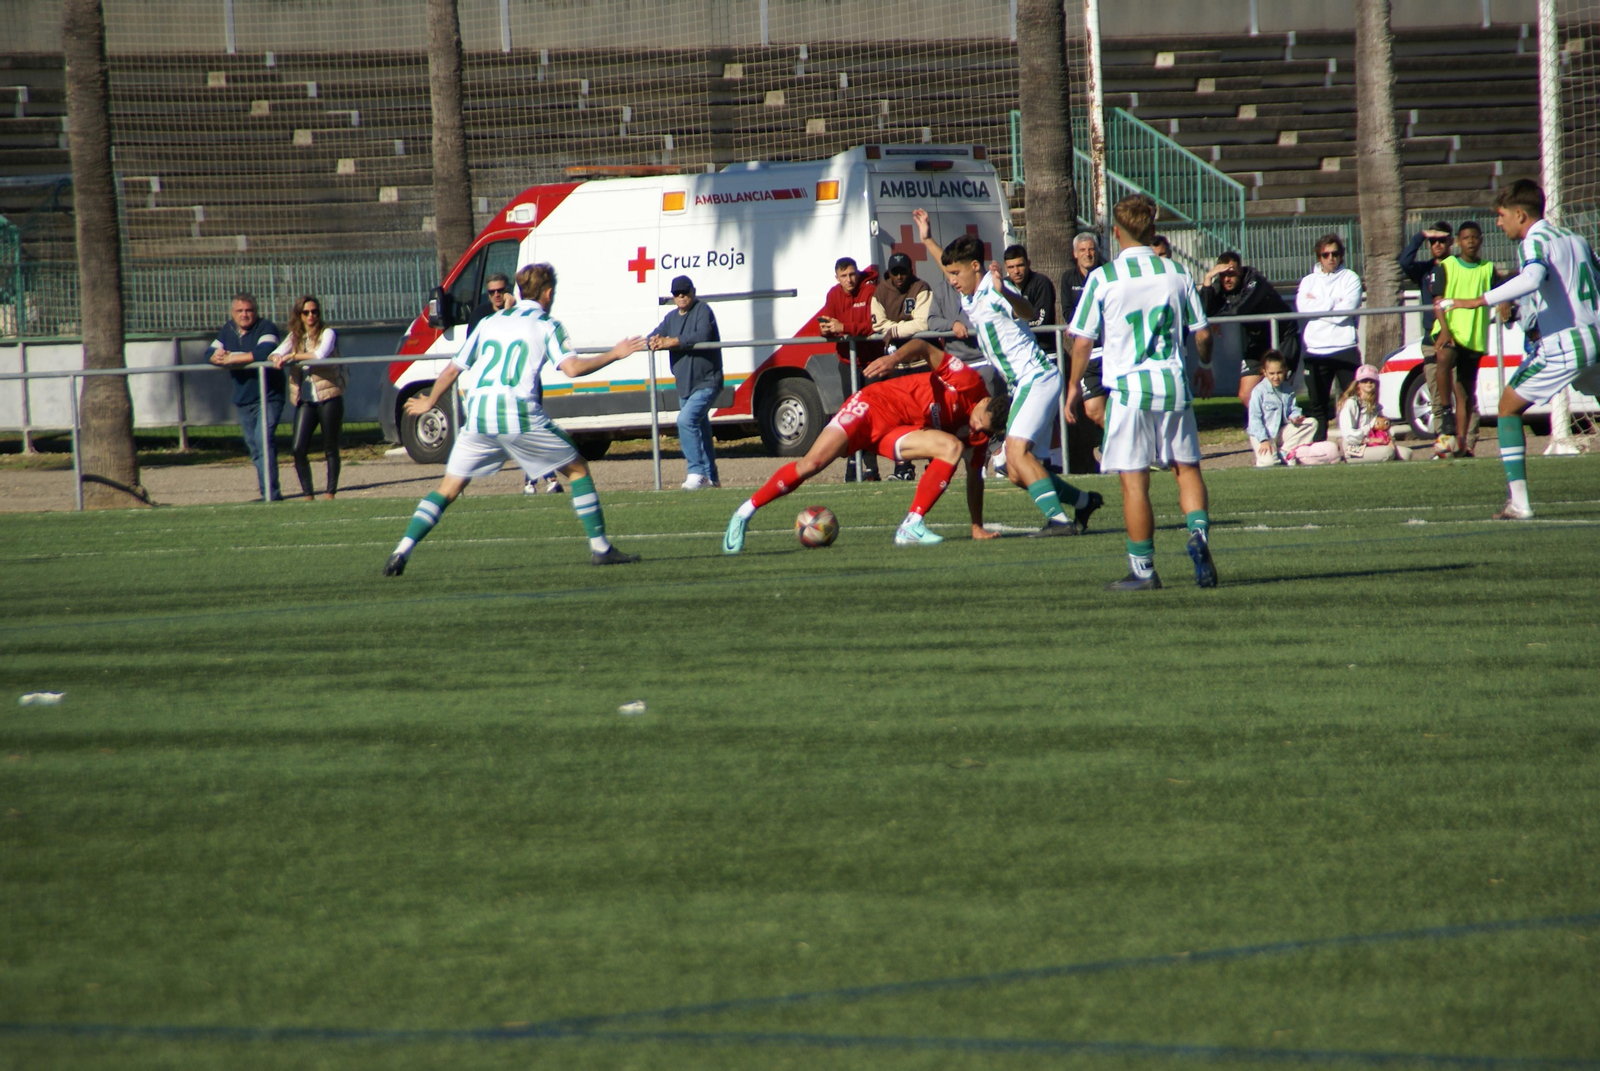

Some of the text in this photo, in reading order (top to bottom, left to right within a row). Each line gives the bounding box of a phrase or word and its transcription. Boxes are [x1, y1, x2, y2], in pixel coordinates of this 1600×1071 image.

[695, 190, 774, 206] AMBULANCIA
[880, 180, 991, 198] AMBULANCIA
[661, 247, 745, 270] Cruz Roja
[1578, 261, 1599, 312] 4
[904, 298, 916, 315] B
[1125, 304, 1175, 365] 18
[477, 338, 529, 389] 20
